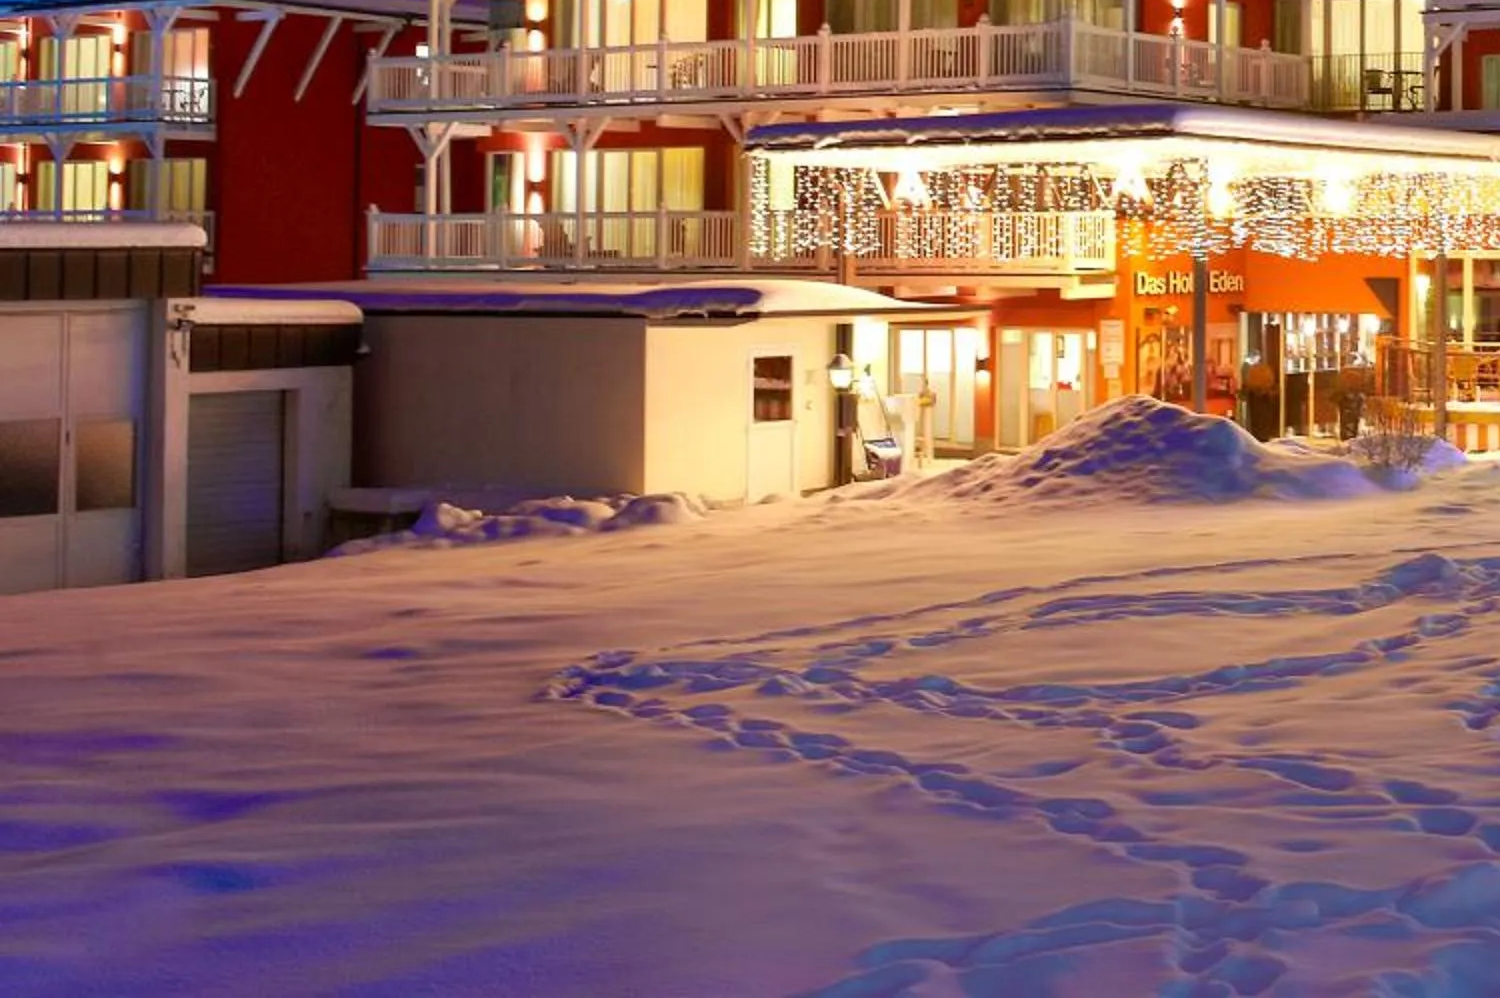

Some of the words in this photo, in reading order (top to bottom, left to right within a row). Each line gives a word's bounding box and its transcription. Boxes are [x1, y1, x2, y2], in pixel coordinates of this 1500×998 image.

[1137, 271, 1166, 294] Das
[1169, 270, 1204, 294] Hot
[1209, 270, 1244, 293] Eden
